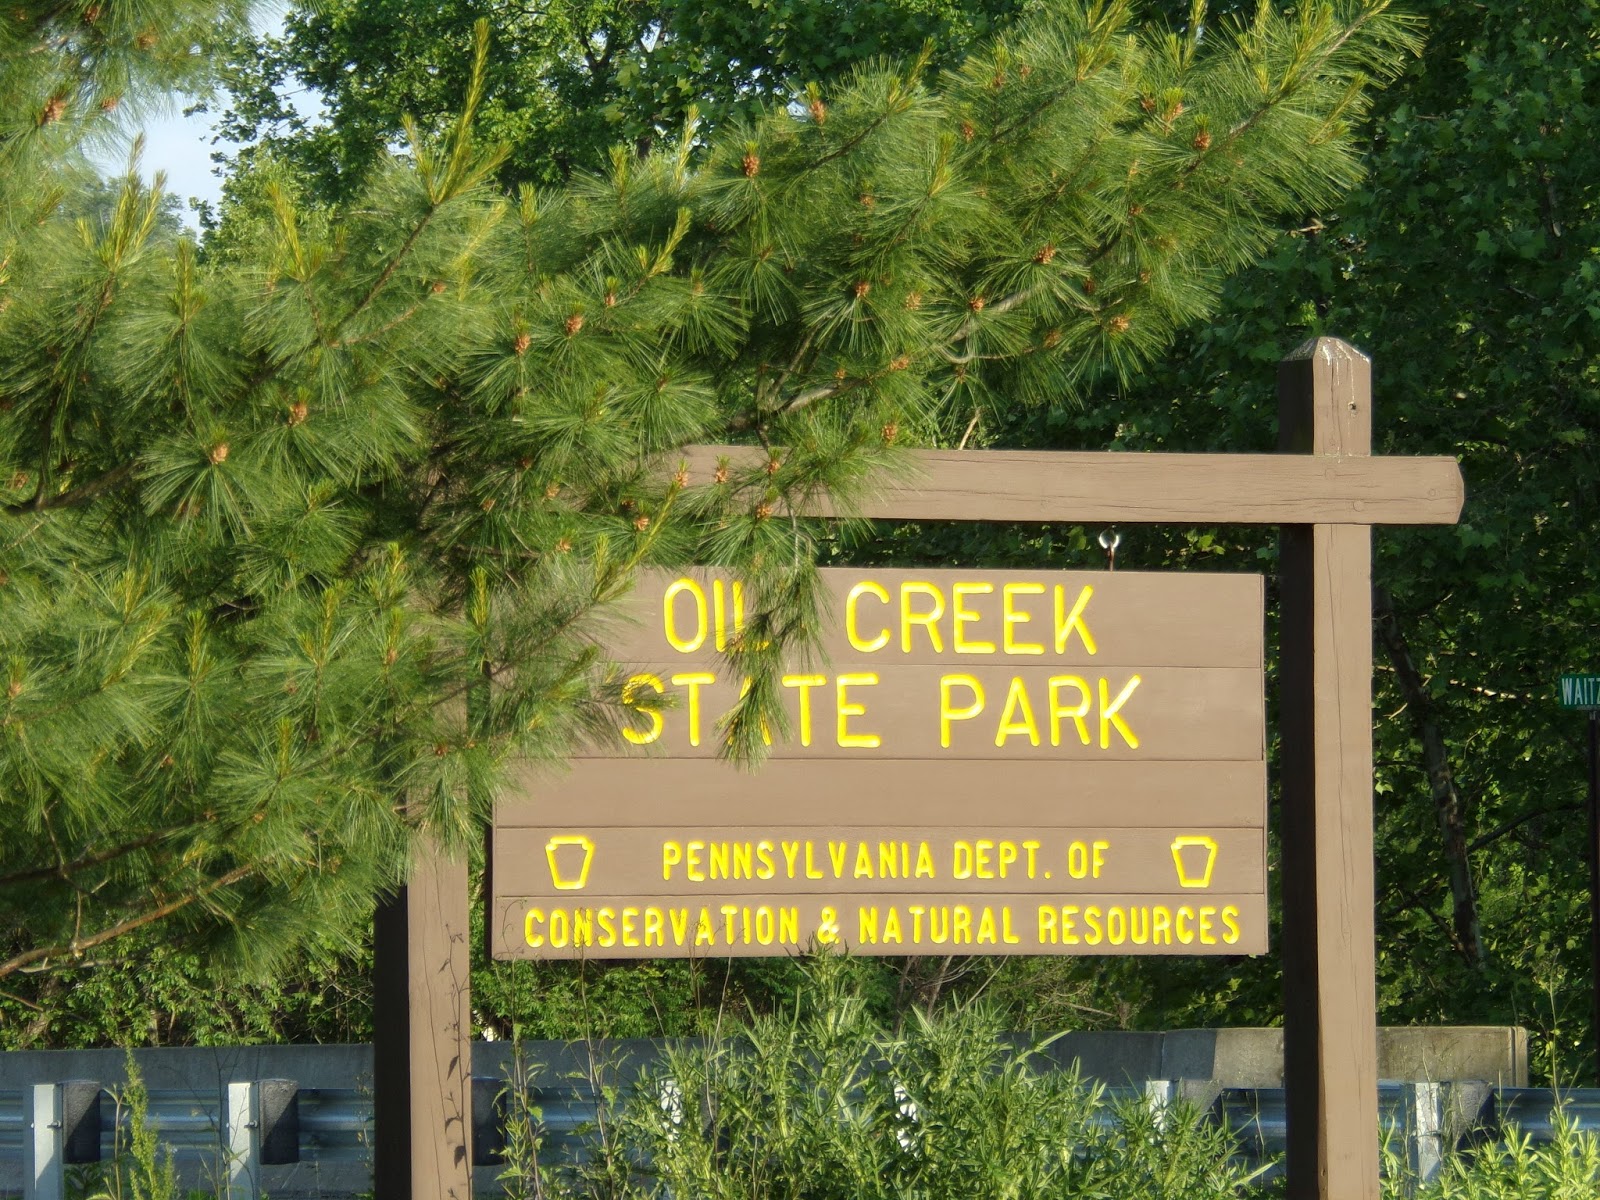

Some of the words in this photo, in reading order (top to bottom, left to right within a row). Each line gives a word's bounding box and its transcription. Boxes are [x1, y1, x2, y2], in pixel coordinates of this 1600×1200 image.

[844, 579, 1098, 656] CREEK
[938, 672, 1142, 751] PARK
[661, 840, 937, 882] PENNSYLVANIA
[951, 839, 1053, 880] DEPT.
[1066, 840, 1111, 880] OF
[522, 904, 800, 949] CONSERVATION
[815, 905, 843, 946] &
[857, 905, 1022, 946] NATURAL
[1036, 904, 1242, 946] RESOURCES
